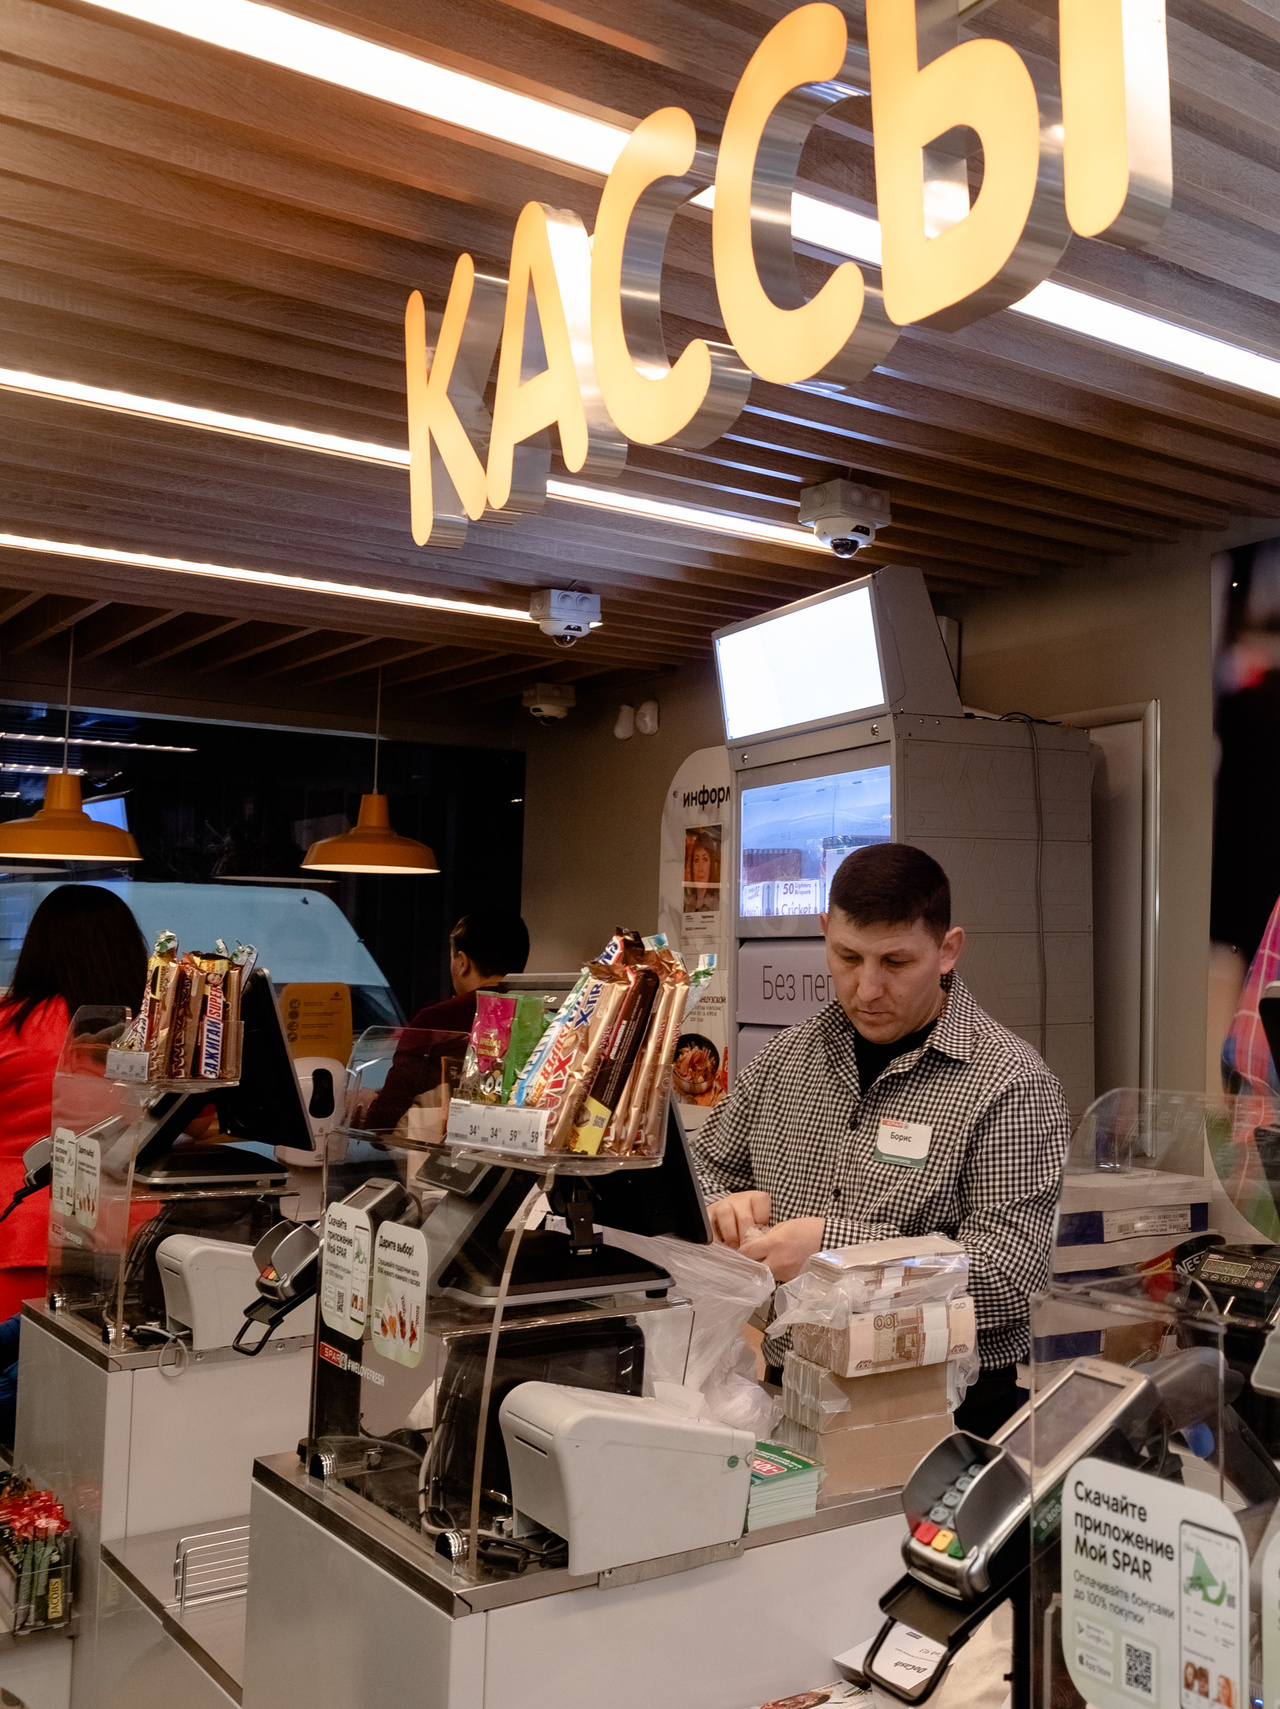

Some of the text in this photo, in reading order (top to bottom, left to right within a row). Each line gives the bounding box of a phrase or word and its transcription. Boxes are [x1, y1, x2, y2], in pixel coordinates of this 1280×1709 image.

[783, 883, 794, 895] 50
[763, 966, 796, 1001] Без
[207, 985, 223, 1018] SUPER
[574, 983, 604, 1031] XTR
[469, 1124, 477, 1136] 34
[490, 1127, 498, 1139] 34
[509, 1130, 518, 1142] 59
[530, 1131, 539, 1143] 59
[890, 1131, 912, 1143] Борис
[1176, 1251, 1205, 1276] NES
[873, 1312, 900, 1331] 100
[324, 1347, 341, 1364] SPAR
[1074, 1480, 1147, 1522] Скачайте
[1075, 1512, 1175, 1561] приложение
[1075, 1535, 1153, 1583] Мой SPAR
[51, 1580, 60, 1616] JACOBS
[1073, 1569, 1176, 1621] Оплачивайте бонусами
[1073, 1588, 1146, 1625] до 100% покупки
